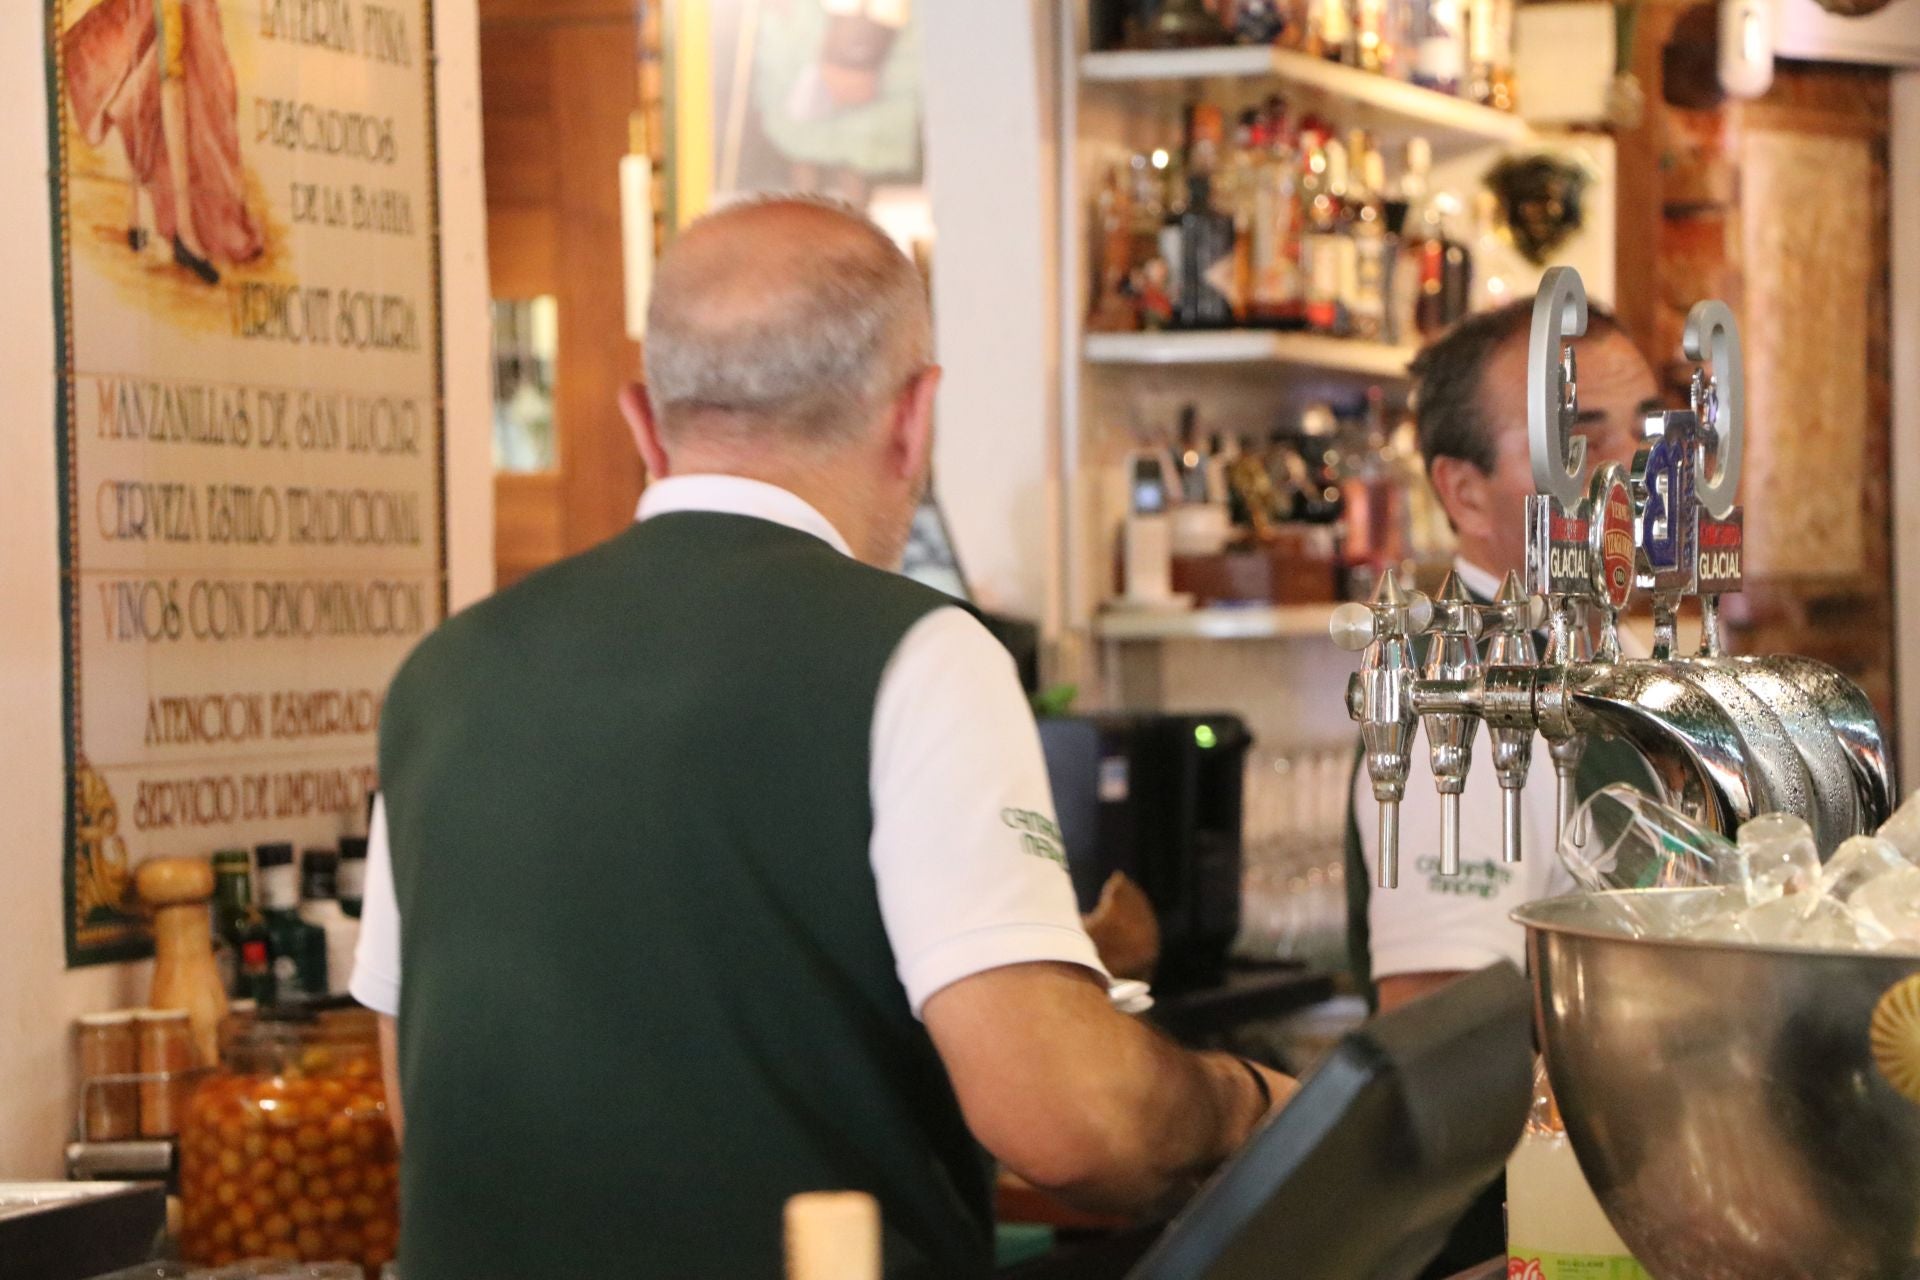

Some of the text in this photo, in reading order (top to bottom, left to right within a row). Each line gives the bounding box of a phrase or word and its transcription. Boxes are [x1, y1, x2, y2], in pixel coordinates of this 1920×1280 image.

[254, 98, 397, 166] PESCADITOS
[290, 182, 318, 224] DE
[326, 187, 347, 227] LA
[336, 287, 421, 354] SOLERA
[95, 377, 252, 450] MANZANILLAS
[257, 390, 290, 450] DE
[296, 390, 341, 452] SAN
[94, 479, 422, 548] CERVEZA ESTILO TRADICIONAL
[1550, 547, 1588, 579] GLACIAL
[1699, 550, 1742, 580] GLACIAL
[97, 579, 424, 643] VINOS CON DENOMINACION
[143, 689, 382, 748] ATENCION ESMERAD
[132, 770, 239, 833] SERVICIO
[241, 769, 268, 824] DE
